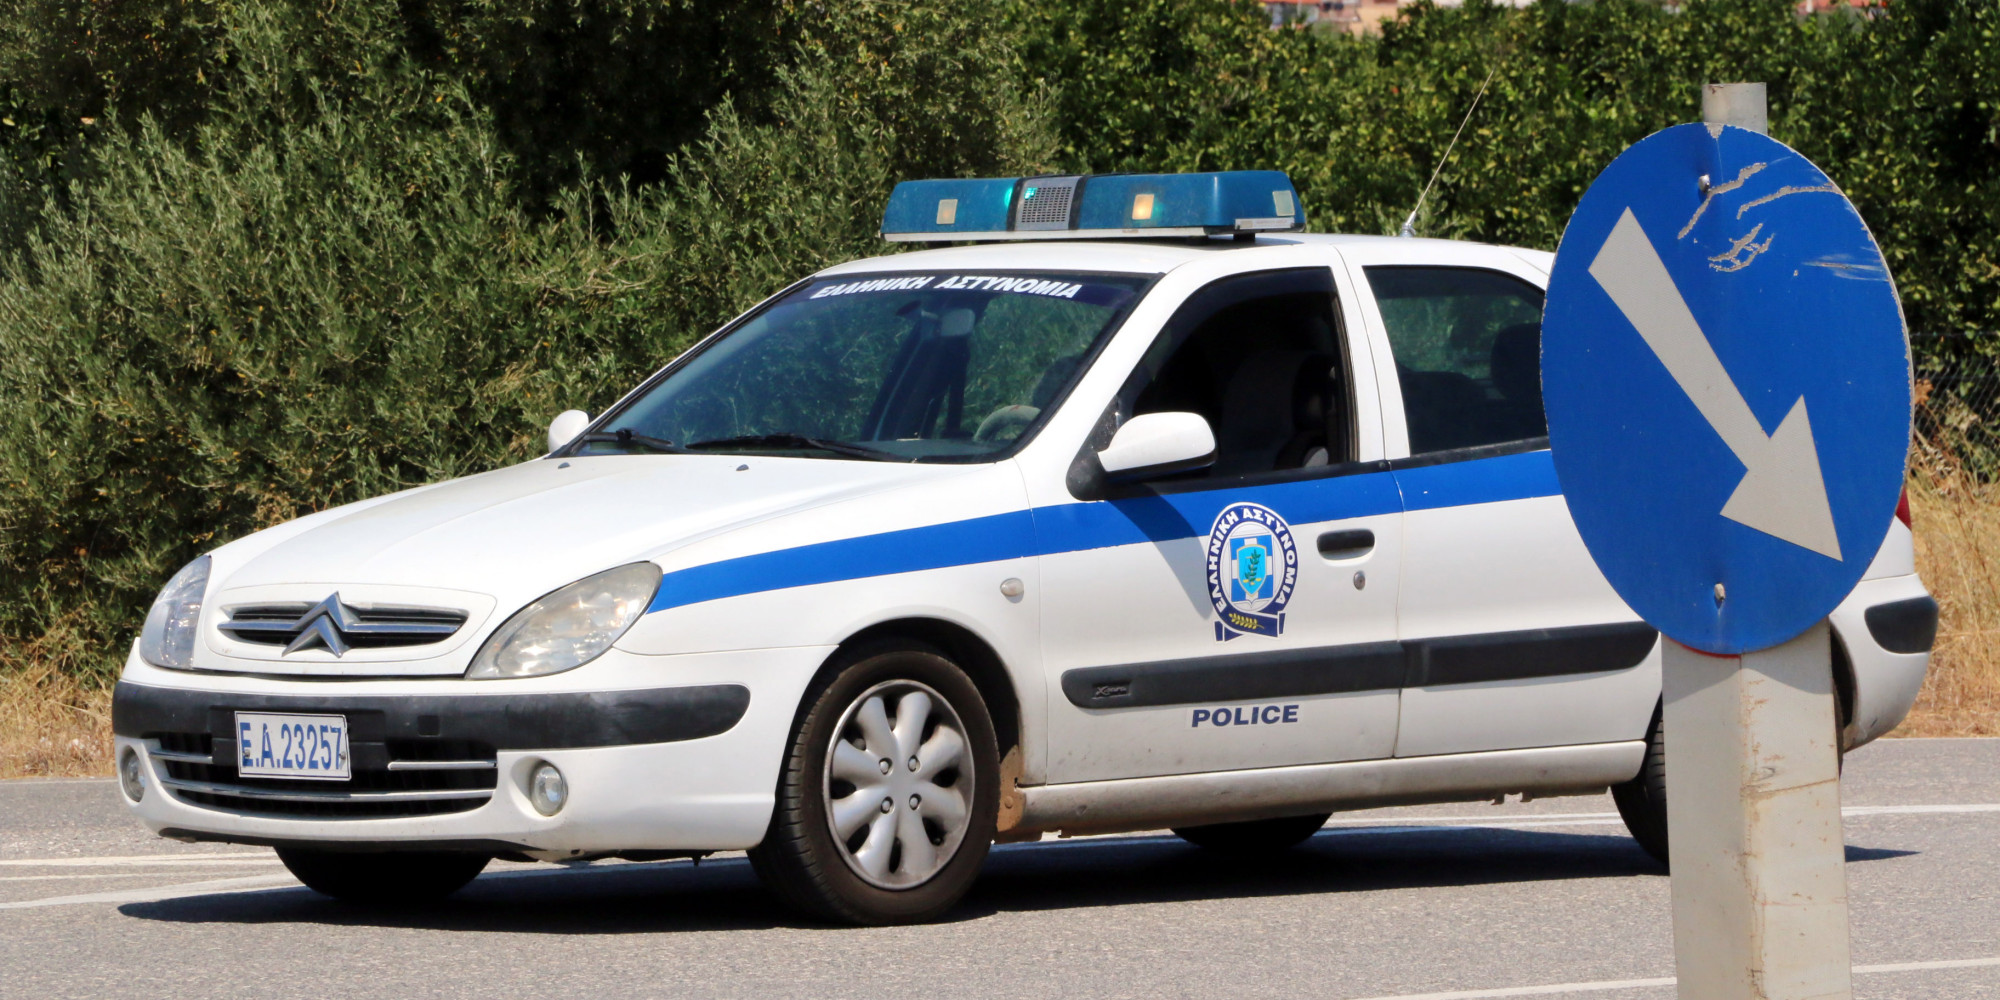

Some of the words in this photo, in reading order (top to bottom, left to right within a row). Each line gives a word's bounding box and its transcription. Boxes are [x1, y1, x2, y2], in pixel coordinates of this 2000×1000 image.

[809, 276, 936, 300] ΕΛΛΗΝΙΚΗ
[933, 275, 1083, 299] ΑΣΤΥΝΟΜΙΑ
[1208, 510, 1239, 613] ΕΛΛΗΝΙΚΗ
[1242, 507, 1296, 605] ΑΣΤΥΝΟΜΙΑ
[1191, 704, 1299, 728] POLICE
